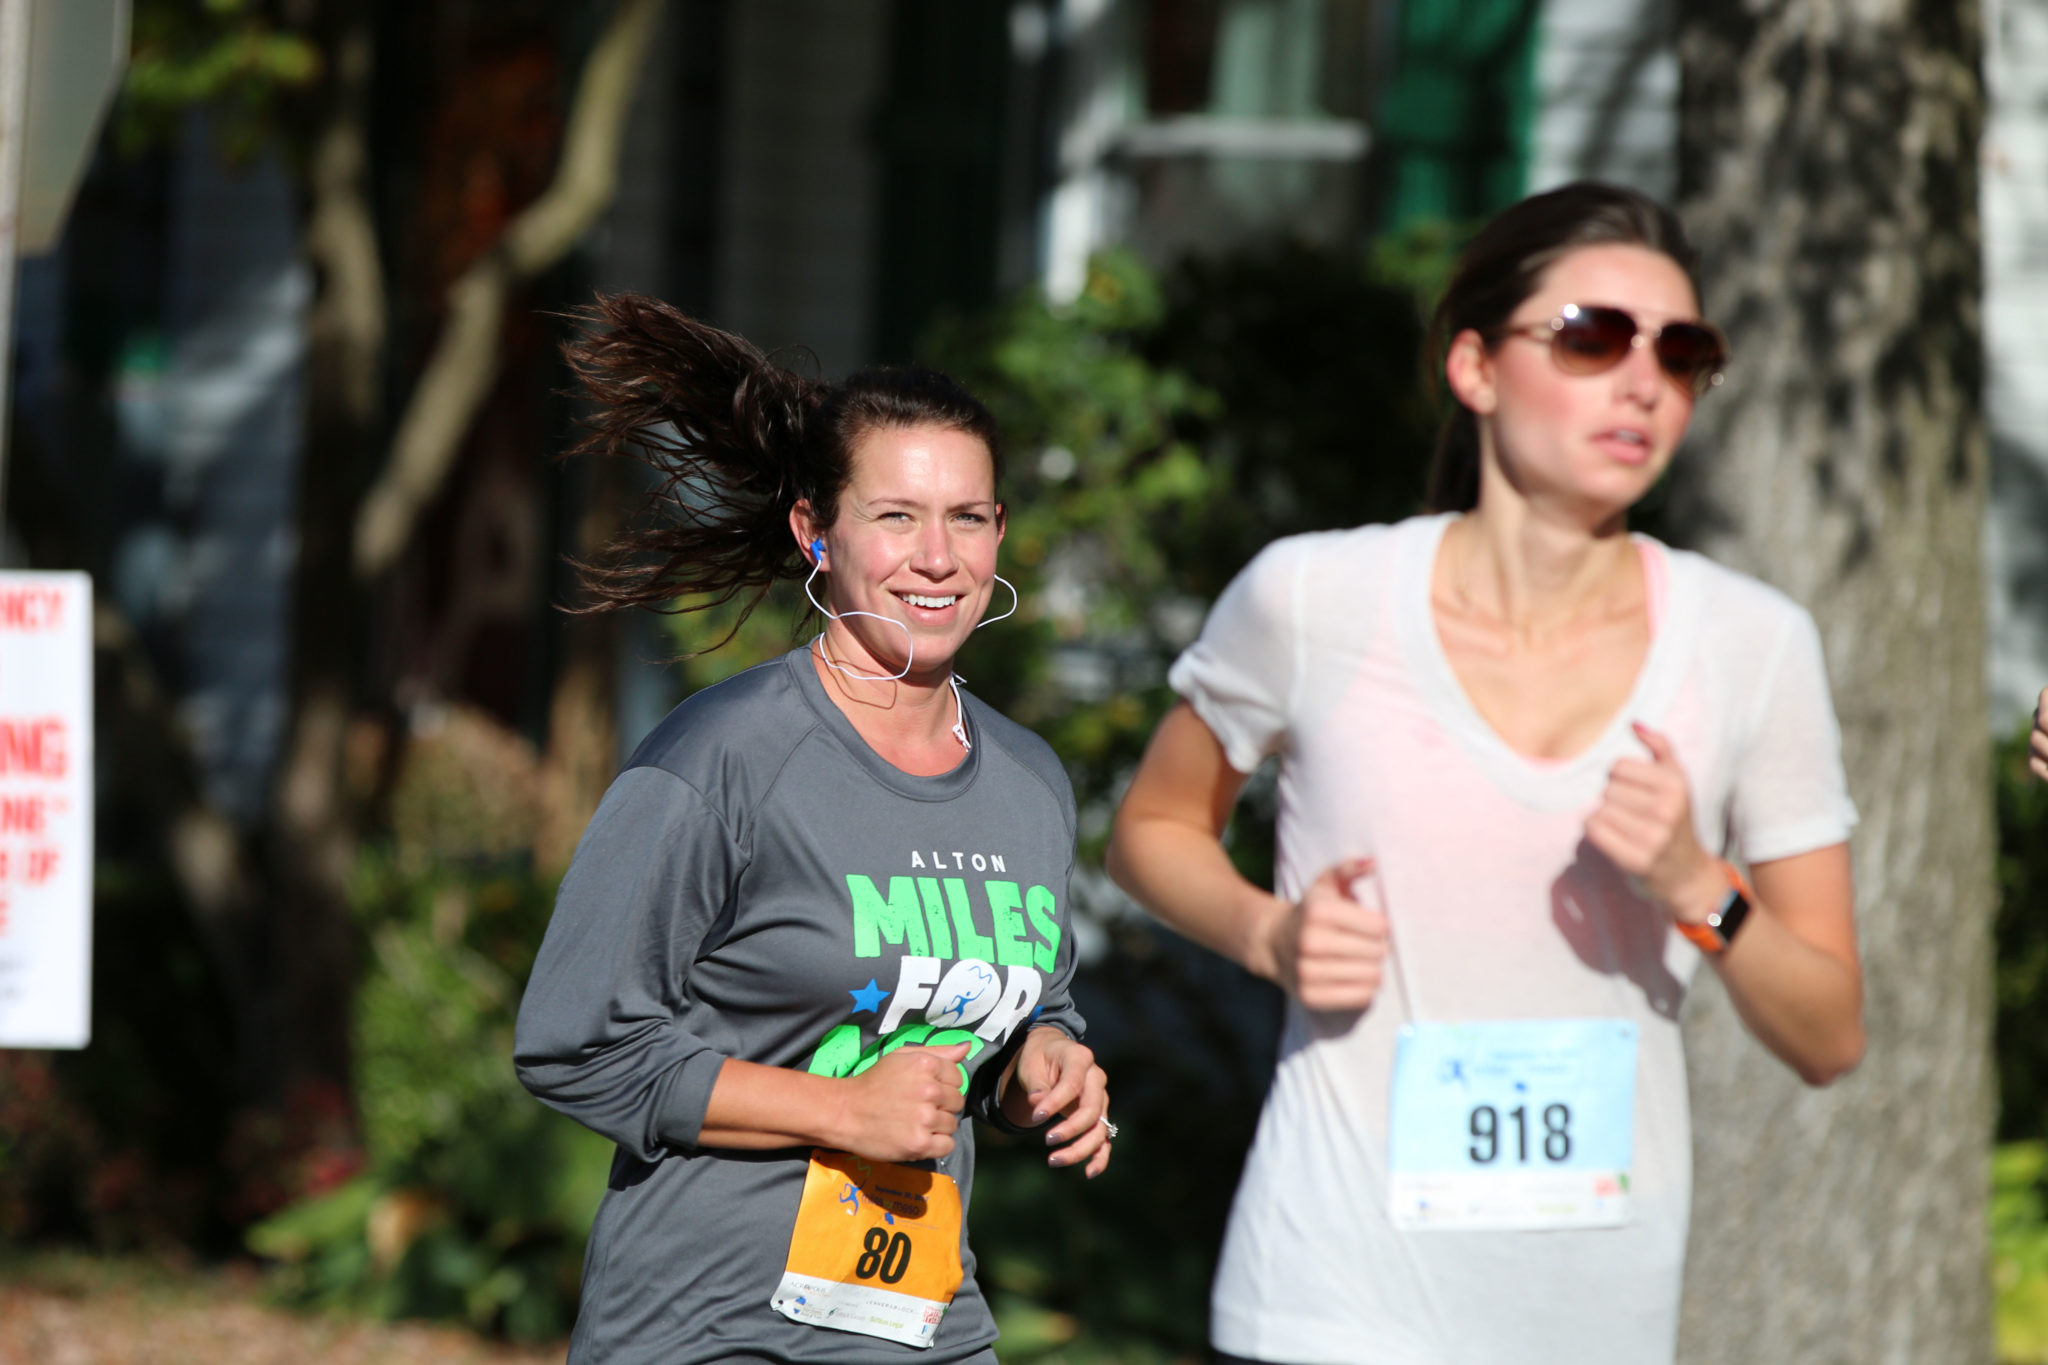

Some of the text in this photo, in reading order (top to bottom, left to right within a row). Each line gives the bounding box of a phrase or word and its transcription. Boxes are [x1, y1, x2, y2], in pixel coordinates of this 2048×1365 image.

[911, 851, 1006, 873] ALTON
[846, 874, 1061, 974] MILES
[878, 955, 1042, 1047] FOR
[1469, 1103, 1571, 1163] 918
[856, 1226, 912, 1284] 80
